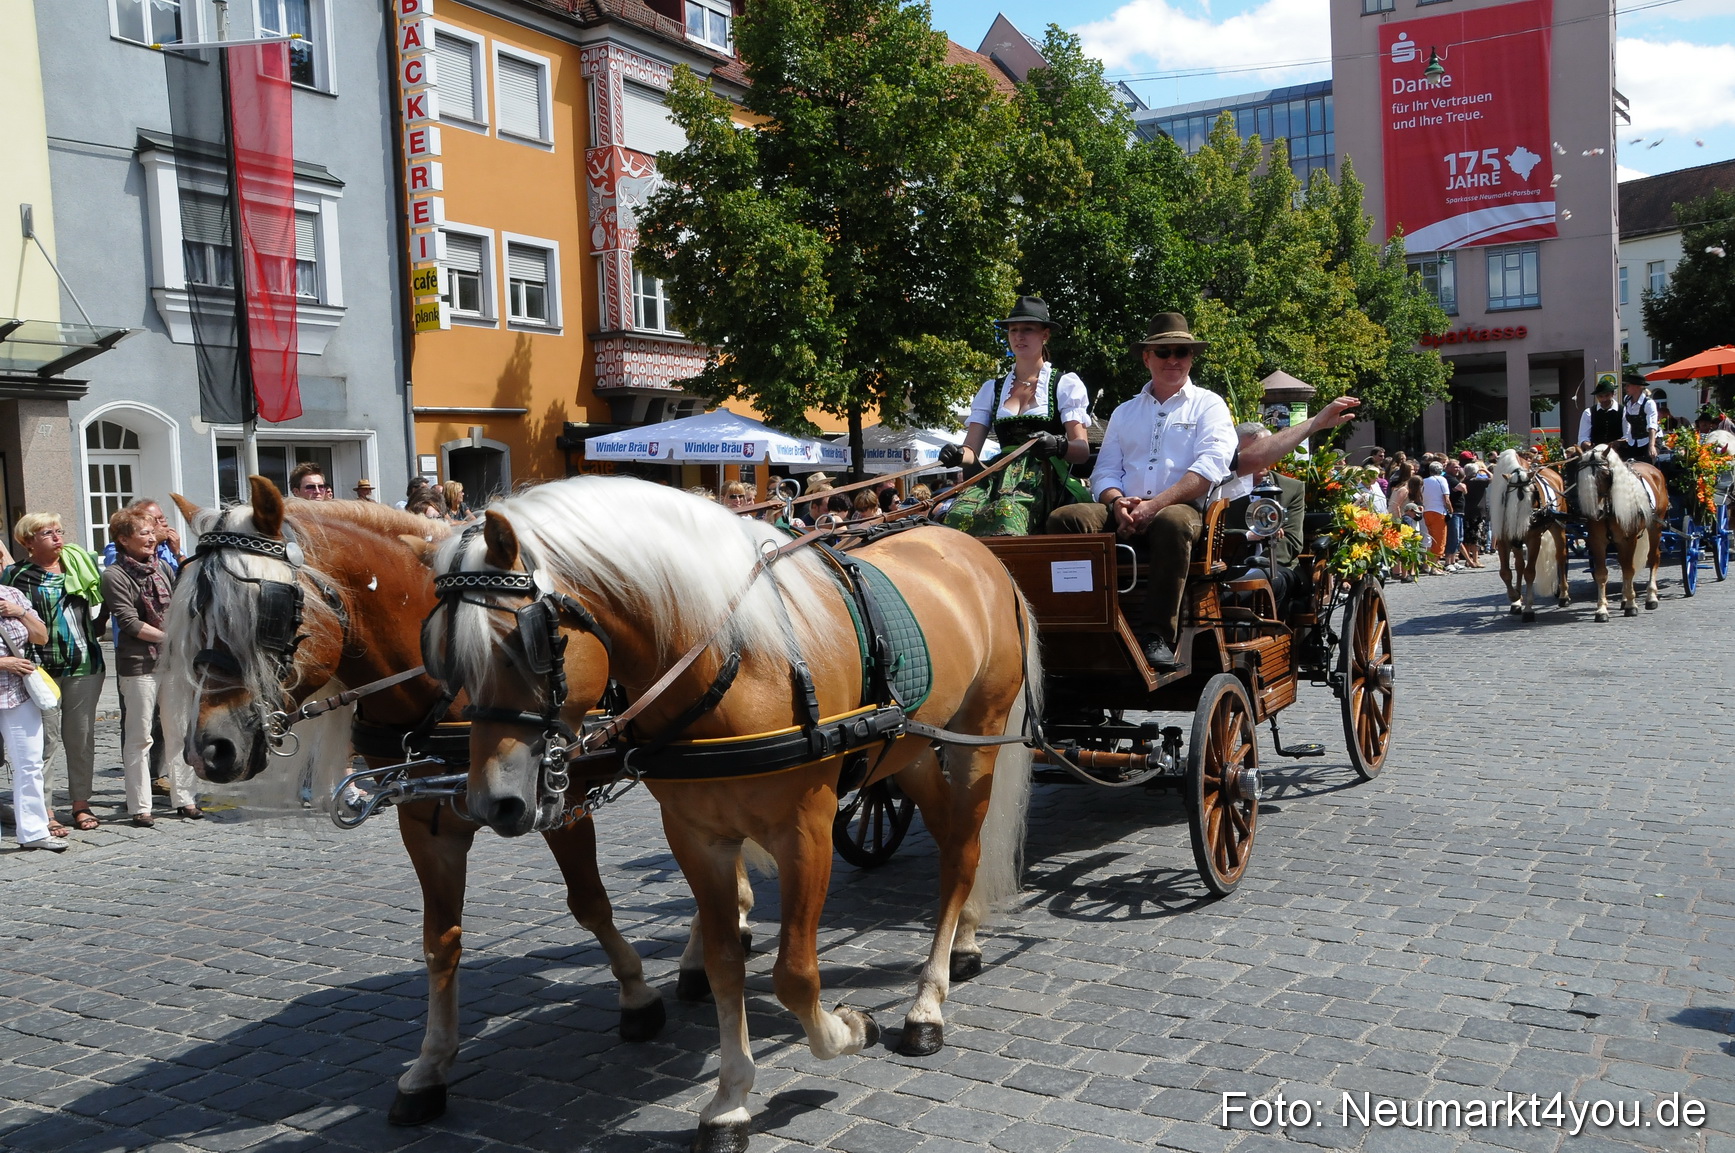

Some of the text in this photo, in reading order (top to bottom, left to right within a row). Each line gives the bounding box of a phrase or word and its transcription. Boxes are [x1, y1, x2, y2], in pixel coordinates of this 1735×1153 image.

[1392, 91, 1493, 115] für Ihr Vertrauen
[1392, 109, 1484, 131] und Ihre Treue.
[1443, 147, 1501, 176] 175
[1445, 171, 1502, 191] JAHRE
[1445, 187, 1541, 205] Sparkasse Neumarkt-Parsberg
[414, 270, 438, 290] café
[415, 307, 440, 328] plank
[38, 424, 53, 437] 47
[596, 441, 648, 453] Winkler Bräu
[684, 441, 743, 453] Winkler Bräu
